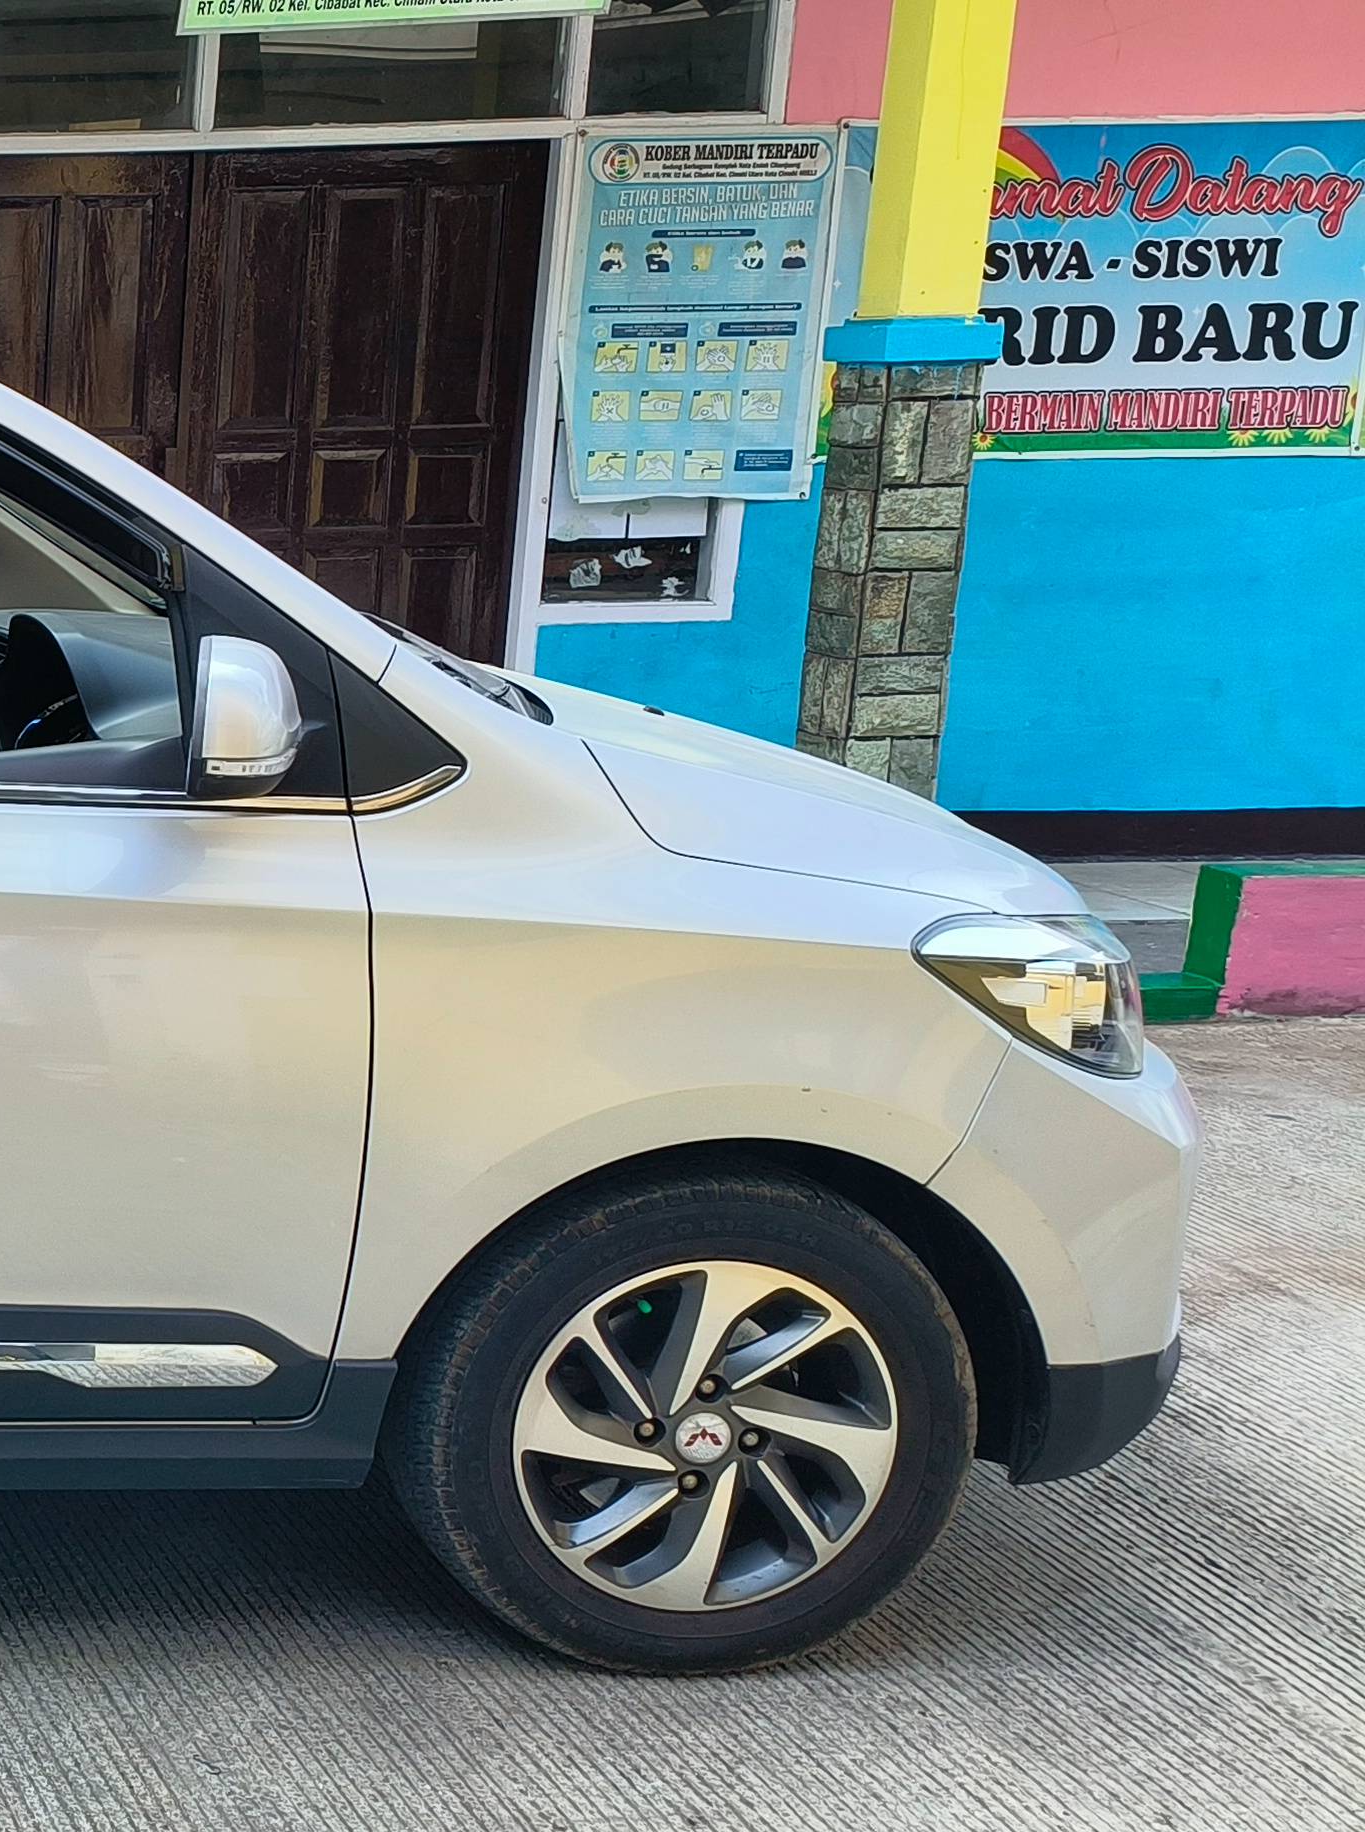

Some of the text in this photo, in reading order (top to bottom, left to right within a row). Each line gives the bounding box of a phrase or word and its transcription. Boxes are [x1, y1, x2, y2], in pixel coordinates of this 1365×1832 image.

[197, 1, 215, 16] RT.
[219, 0, 265, 17] 05/RW.
[269, 0, 284, 12] 02
[644, 142, 821, 162] KOBER MANDIRI TERPADU
[619, 183, 799, 208] ETIKA BERSIN, BATUK, DAN
[1124, 143, 1364, 238] Datang
[600, 199, 815, 227] CARA CUCI TANGAN YANG BENAR
[983, 241, 1095, 281] SWA
[1132, 237, 1284, 280] SISWI
[978, 300, 1360, 366] RID BARU
[984, 386, 1350, 434] BERMAIN MANDIRI TERPADU
